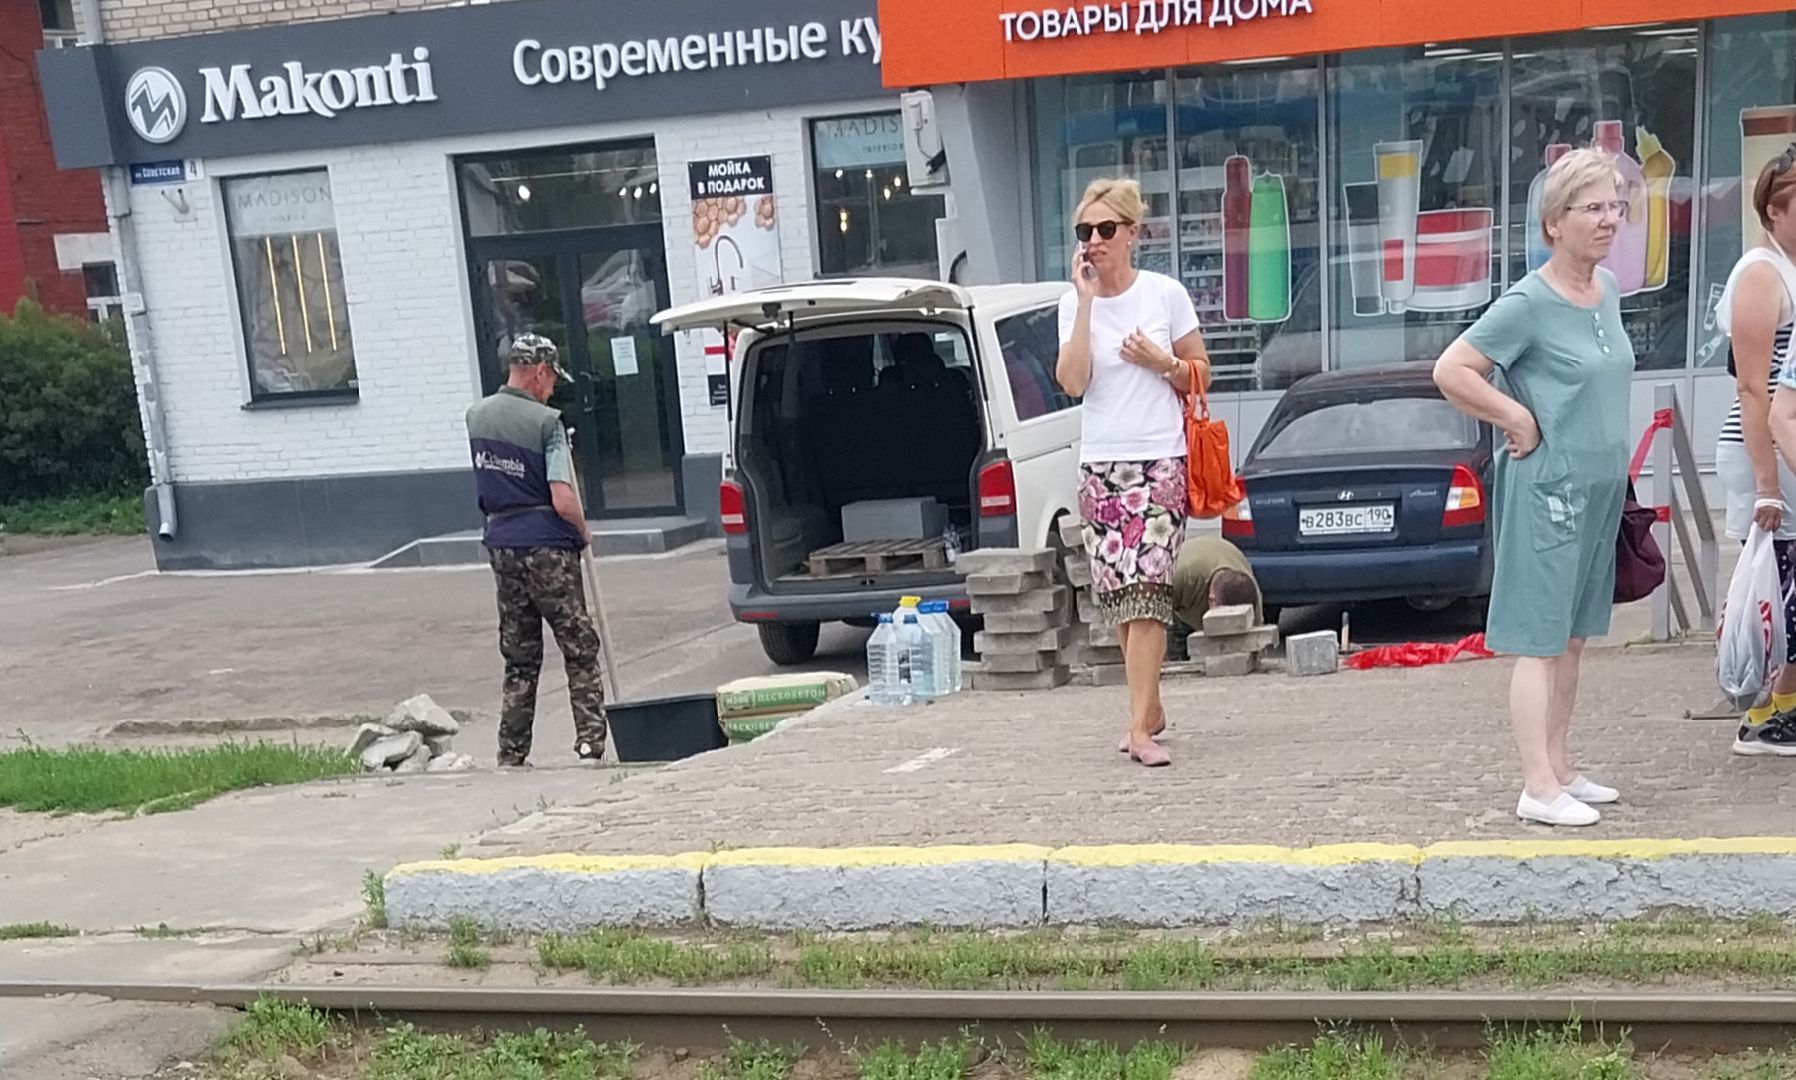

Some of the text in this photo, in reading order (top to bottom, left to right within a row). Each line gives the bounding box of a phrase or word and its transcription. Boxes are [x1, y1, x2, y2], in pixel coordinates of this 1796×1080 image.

[1000, 0, 1312, 41] ТОВАРЫ ДЛЯ ДОМА
[513, 21, 828, 90] Современные
[199, 46, 438, 122] Makonti
[708, 160, 751, 177] МОЙКА
[237, 185, 332, 209] MADISON
[697, 177, 765, 195] В ПОДАРОК
